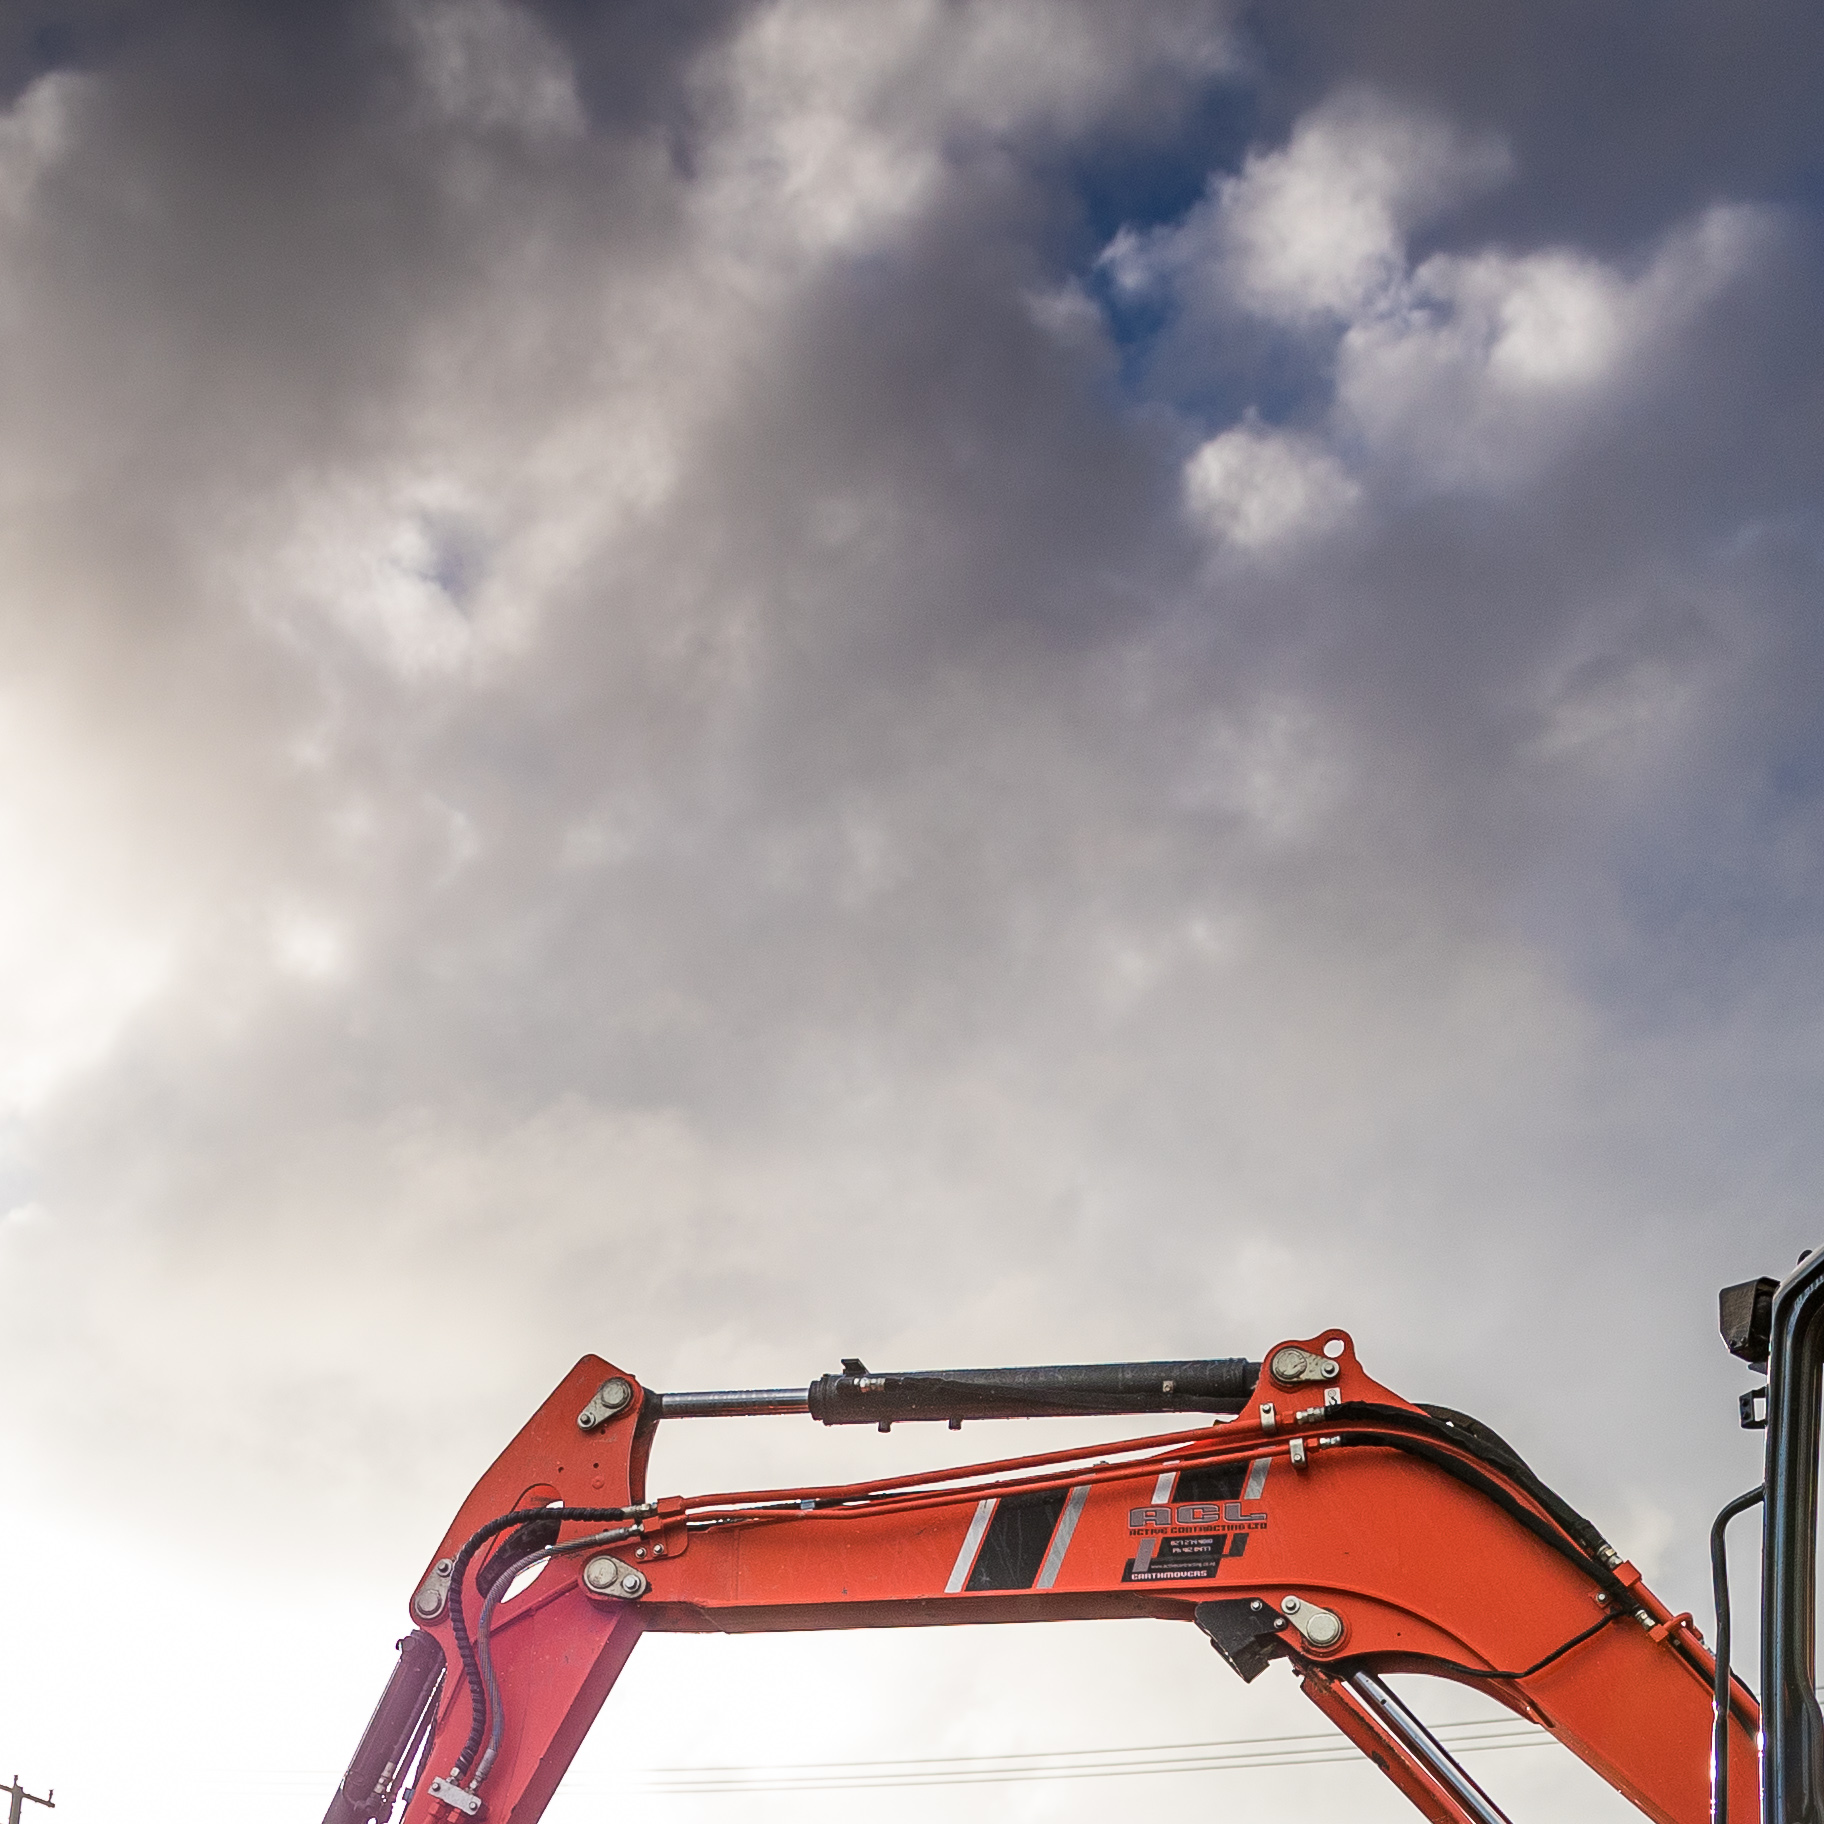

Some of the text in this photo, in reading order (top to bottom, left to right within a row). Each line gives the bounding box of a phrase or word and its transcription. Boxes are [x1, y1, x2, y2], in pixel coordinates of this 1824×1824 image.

[1128, 1502, 1267, 1529] ACL
[1129, 1522, 1268, 1536] ACTIVE CONTRACTING LTD
[1131, 1570, 1208, 1580] EARTHMOVERS
